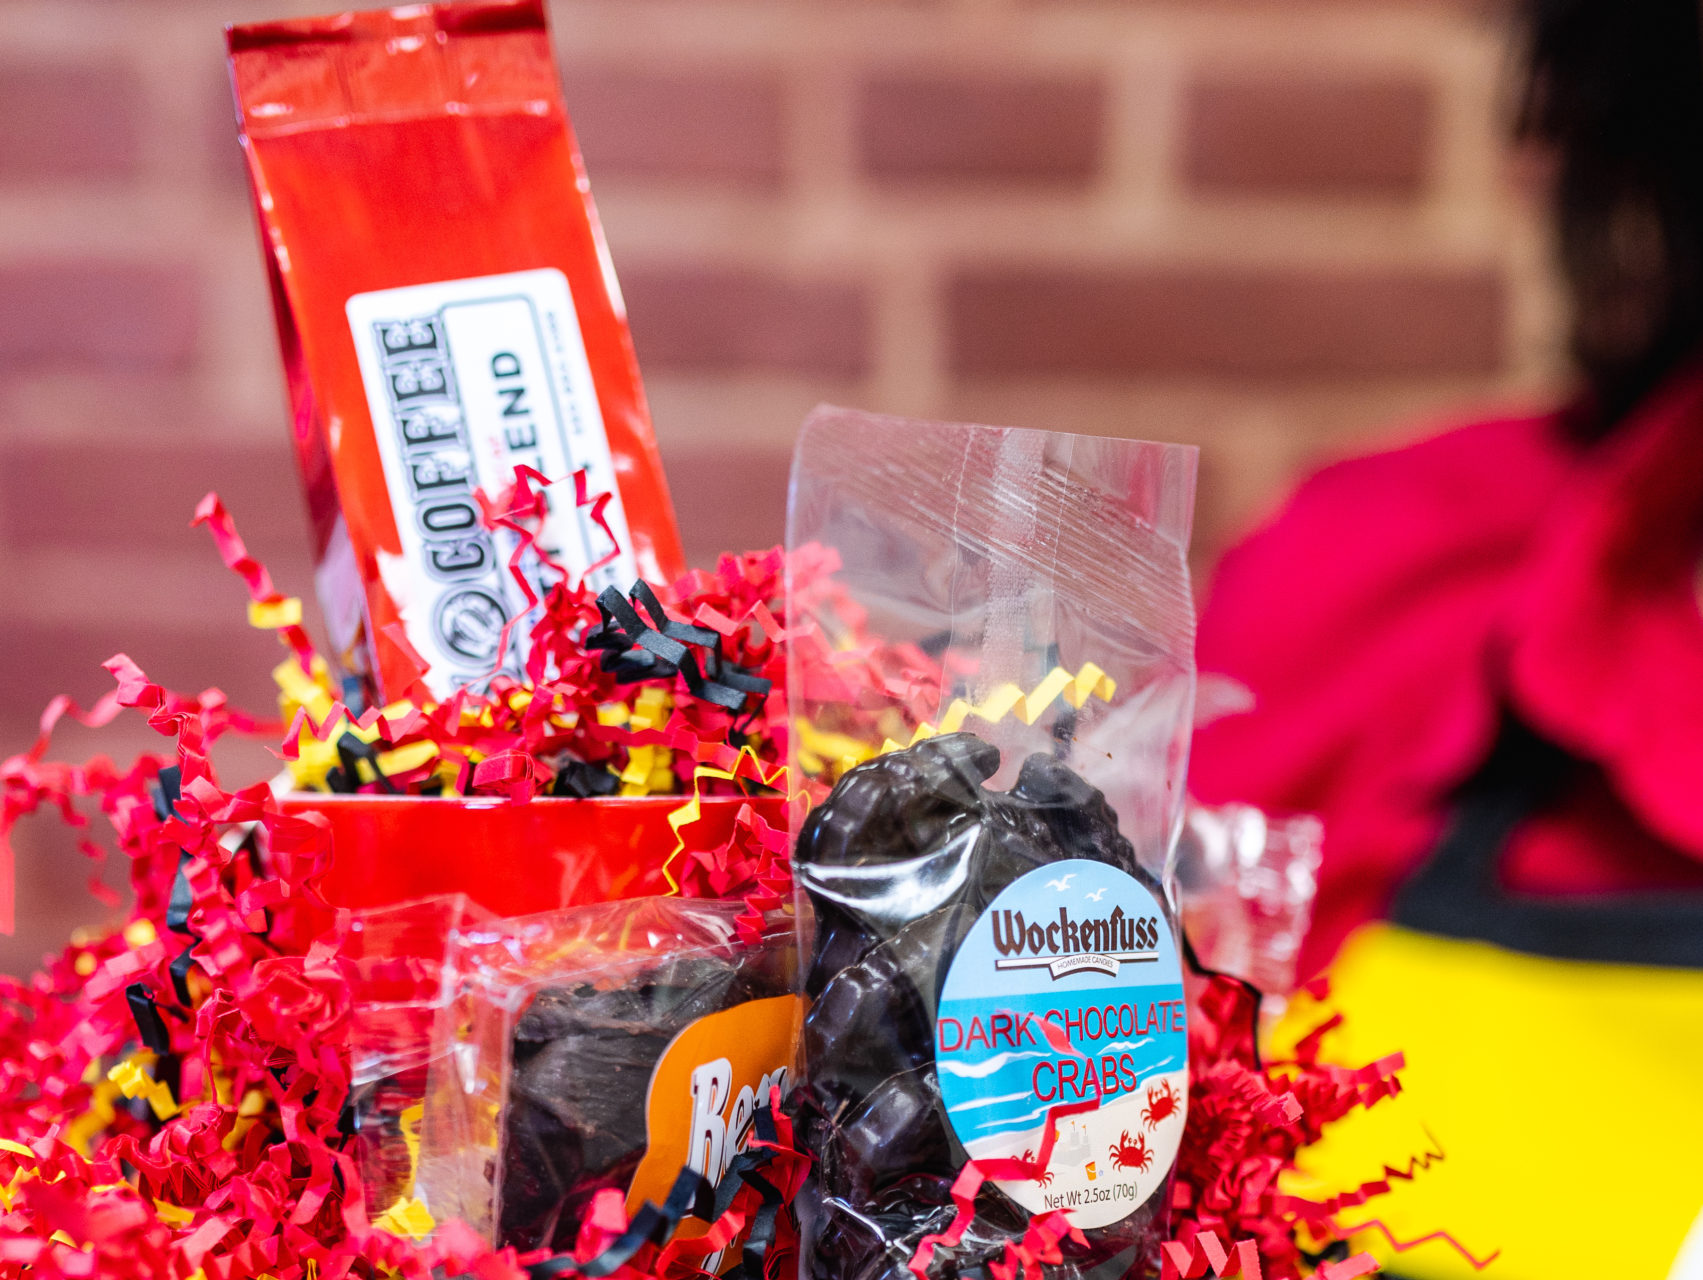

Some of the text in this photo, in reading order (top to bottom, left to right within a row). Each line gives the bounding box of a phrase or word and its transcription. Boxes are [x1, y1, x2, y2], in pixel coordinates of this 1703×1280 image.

[378, 319, 490, 575] COFFEE
[991, 904, 1159, 957] Wockenfuss
[1056, 955, 1114, 969] HOMEMADE CANDIES
[937, 1011, 1037, 1052] DARK
[1032, 1053, 1137, 1102] CRABS
[1044, 1181, 1138, 1209] Net Wt 2.5oz (70g)
